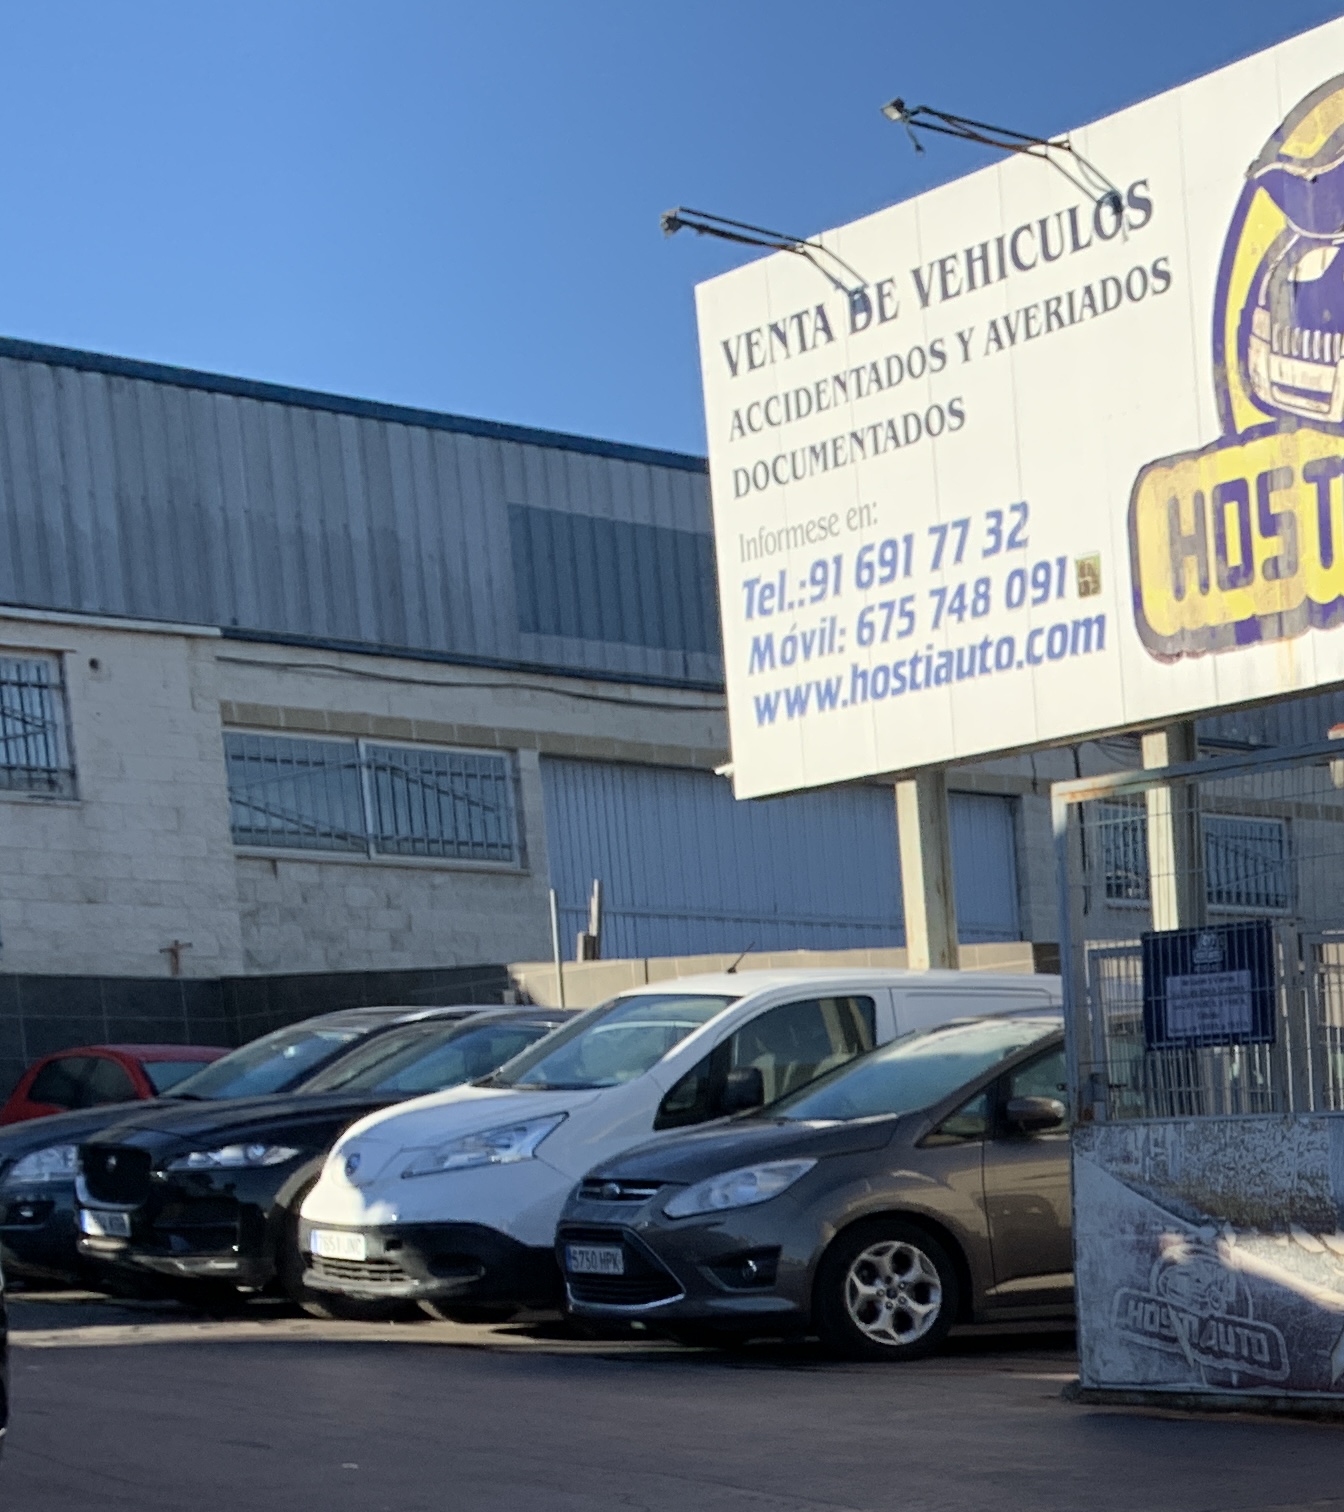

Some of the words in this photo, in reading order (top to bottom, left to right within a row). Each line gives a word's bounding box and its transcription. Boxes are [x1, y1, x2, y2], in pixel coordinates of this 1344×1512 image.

[721, 304, 836, 379] VENTA
[848, 277, 901, 335] DE
[912, 179, 1154, 310] VEHICULOS
[729, 338, 949, 441] ACCIDENTADOS
[957, 326, 977, 364] Y
[984, 256, 1173, 357] AVERIADOS
[732, 397, 967, 499] DOCUMENTADOS
[739, 510, 841, 563] Informese
[846, 500, 879, 534] en:
[855, 534, 916, 591] 691
[930, 522, 970, 573] 77
[981, 501, 1031, 560] 32
[749, 616, 847, 675] Móvil:
[857, 600, 917, 648] 675
[930, 582, 992, 635] 748
[1005, 556, 1067, 612] 091
[754, 611, 1107, 727] www.hostiauto.com
